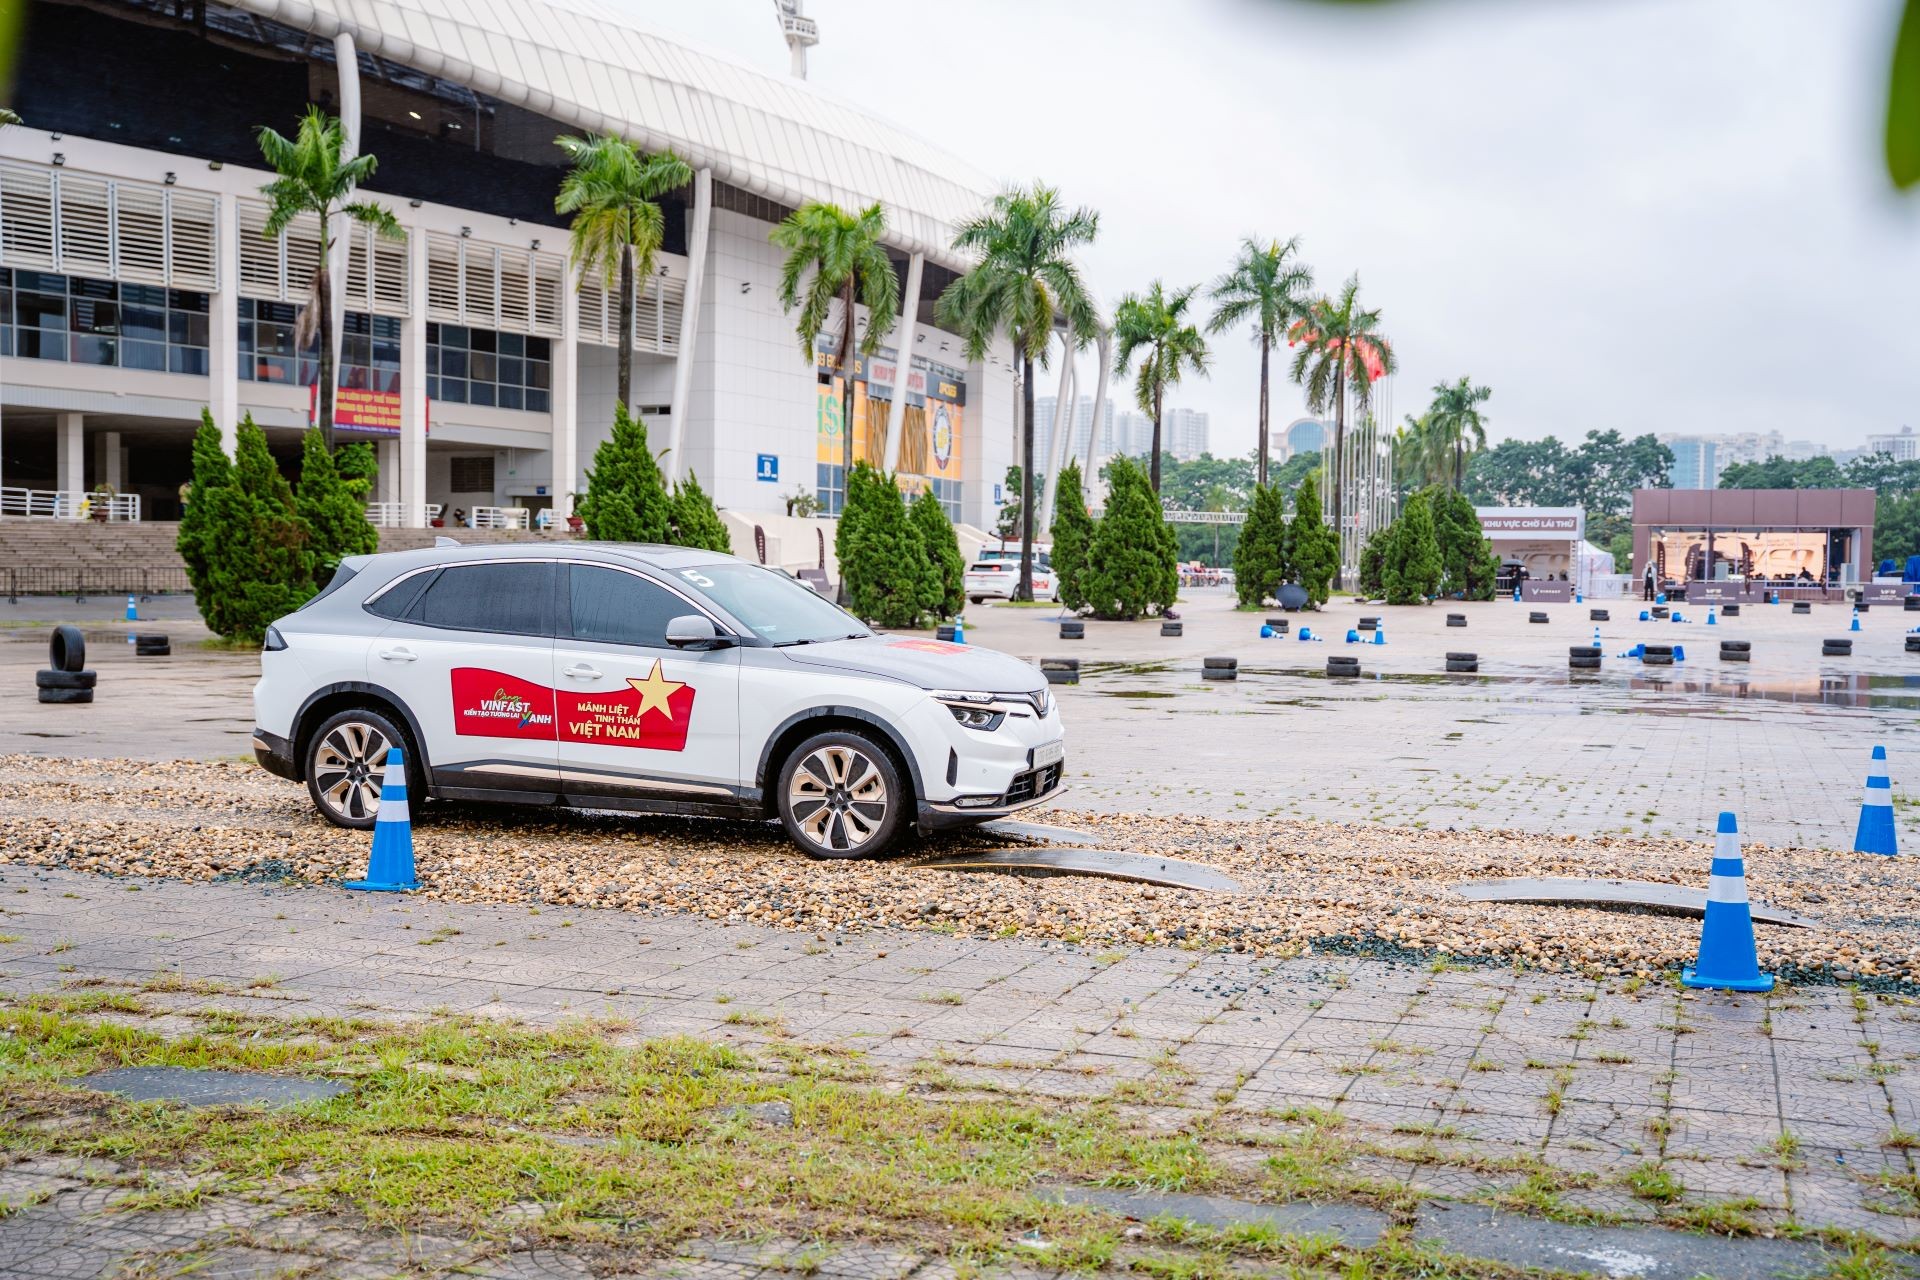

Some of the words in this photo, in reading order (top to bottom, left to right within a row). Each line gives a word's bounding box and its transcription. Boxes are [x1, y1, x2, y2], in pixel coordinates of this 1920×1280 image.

[764, 461, 772, 477] B
[1484, 520, 1501, 528] KHU
[1503, 520, 1521, 529] VỰC
[1522, 519, 1540, 528] CHỜ
[1541, 519, 1554, 528] LÁI
[680, 570, 715, 588] 5
[463, 708, 478, 716] KIẾN
[478, 710, 490, 718] TẠO
[480, 699, 531, 713] VINFAST
[577, 701, 606, 713] MÃNH
[608, 704, 629, 716] LIỆT
[594, 714, 615, 723] TINH
[569, 720, 603, 739] VIỆT
[606, 725, 640, 740] NAM
